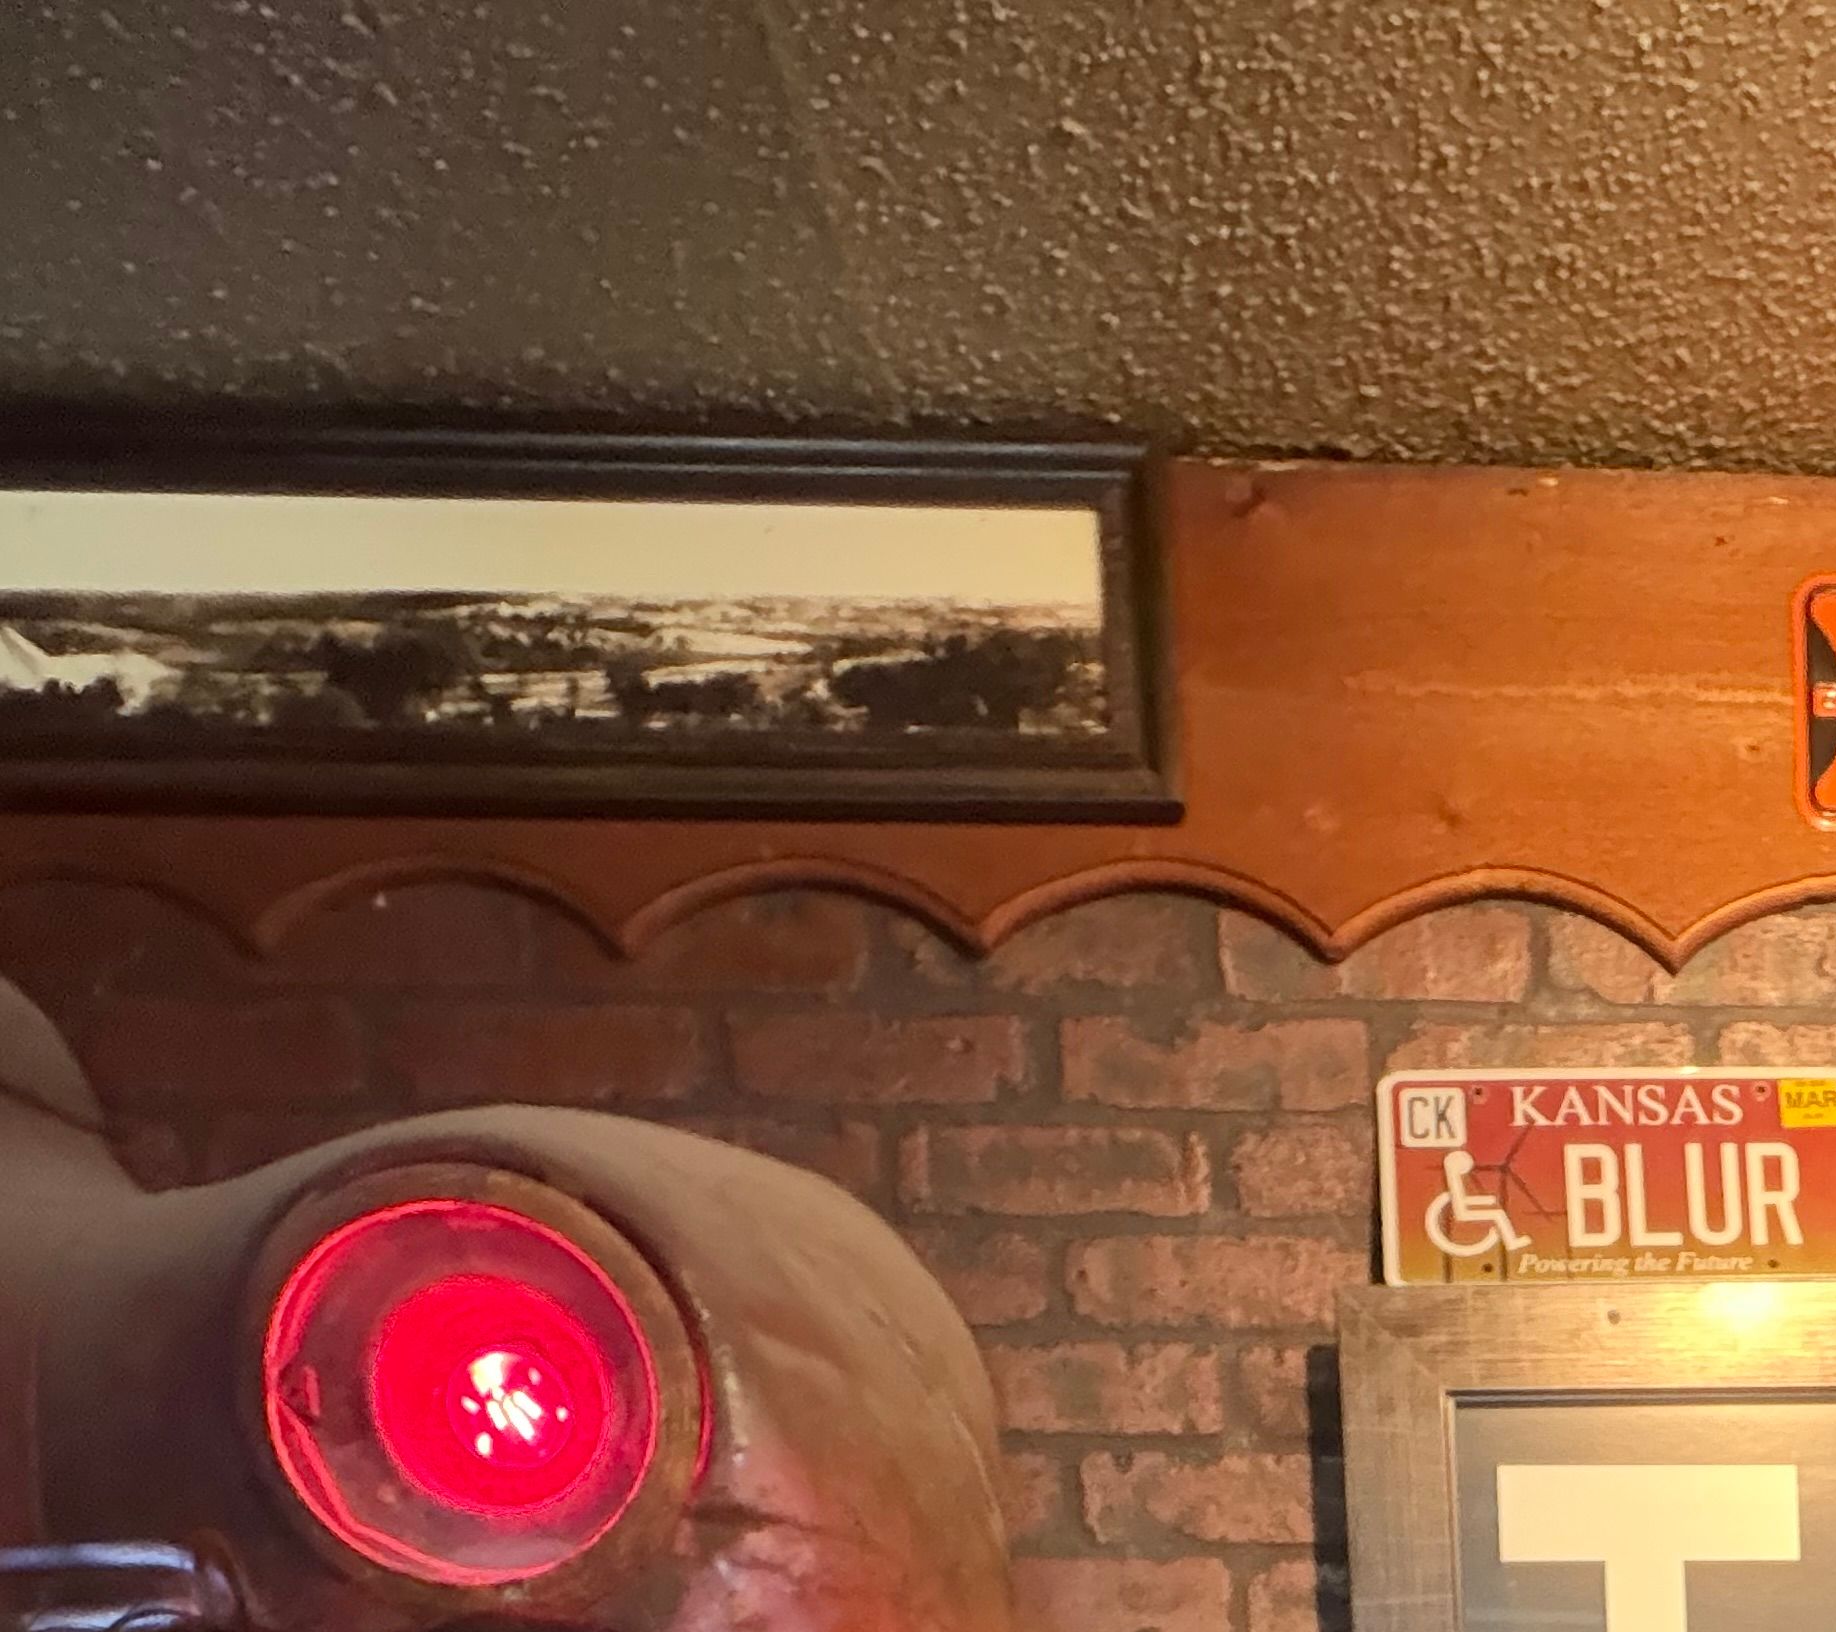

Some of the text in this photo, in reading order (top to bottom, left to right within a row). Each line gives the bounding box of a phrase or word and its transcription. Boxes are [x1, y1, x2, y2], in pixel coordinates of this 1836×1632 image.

[1407, 1095, 1457, 1140] CK
[1509, 1084, 1744, 1127] KANSAS
[1563, 1141, 1805, 1249] BLUR
[1517, 1251, 1754, 1278] Powering the Future
